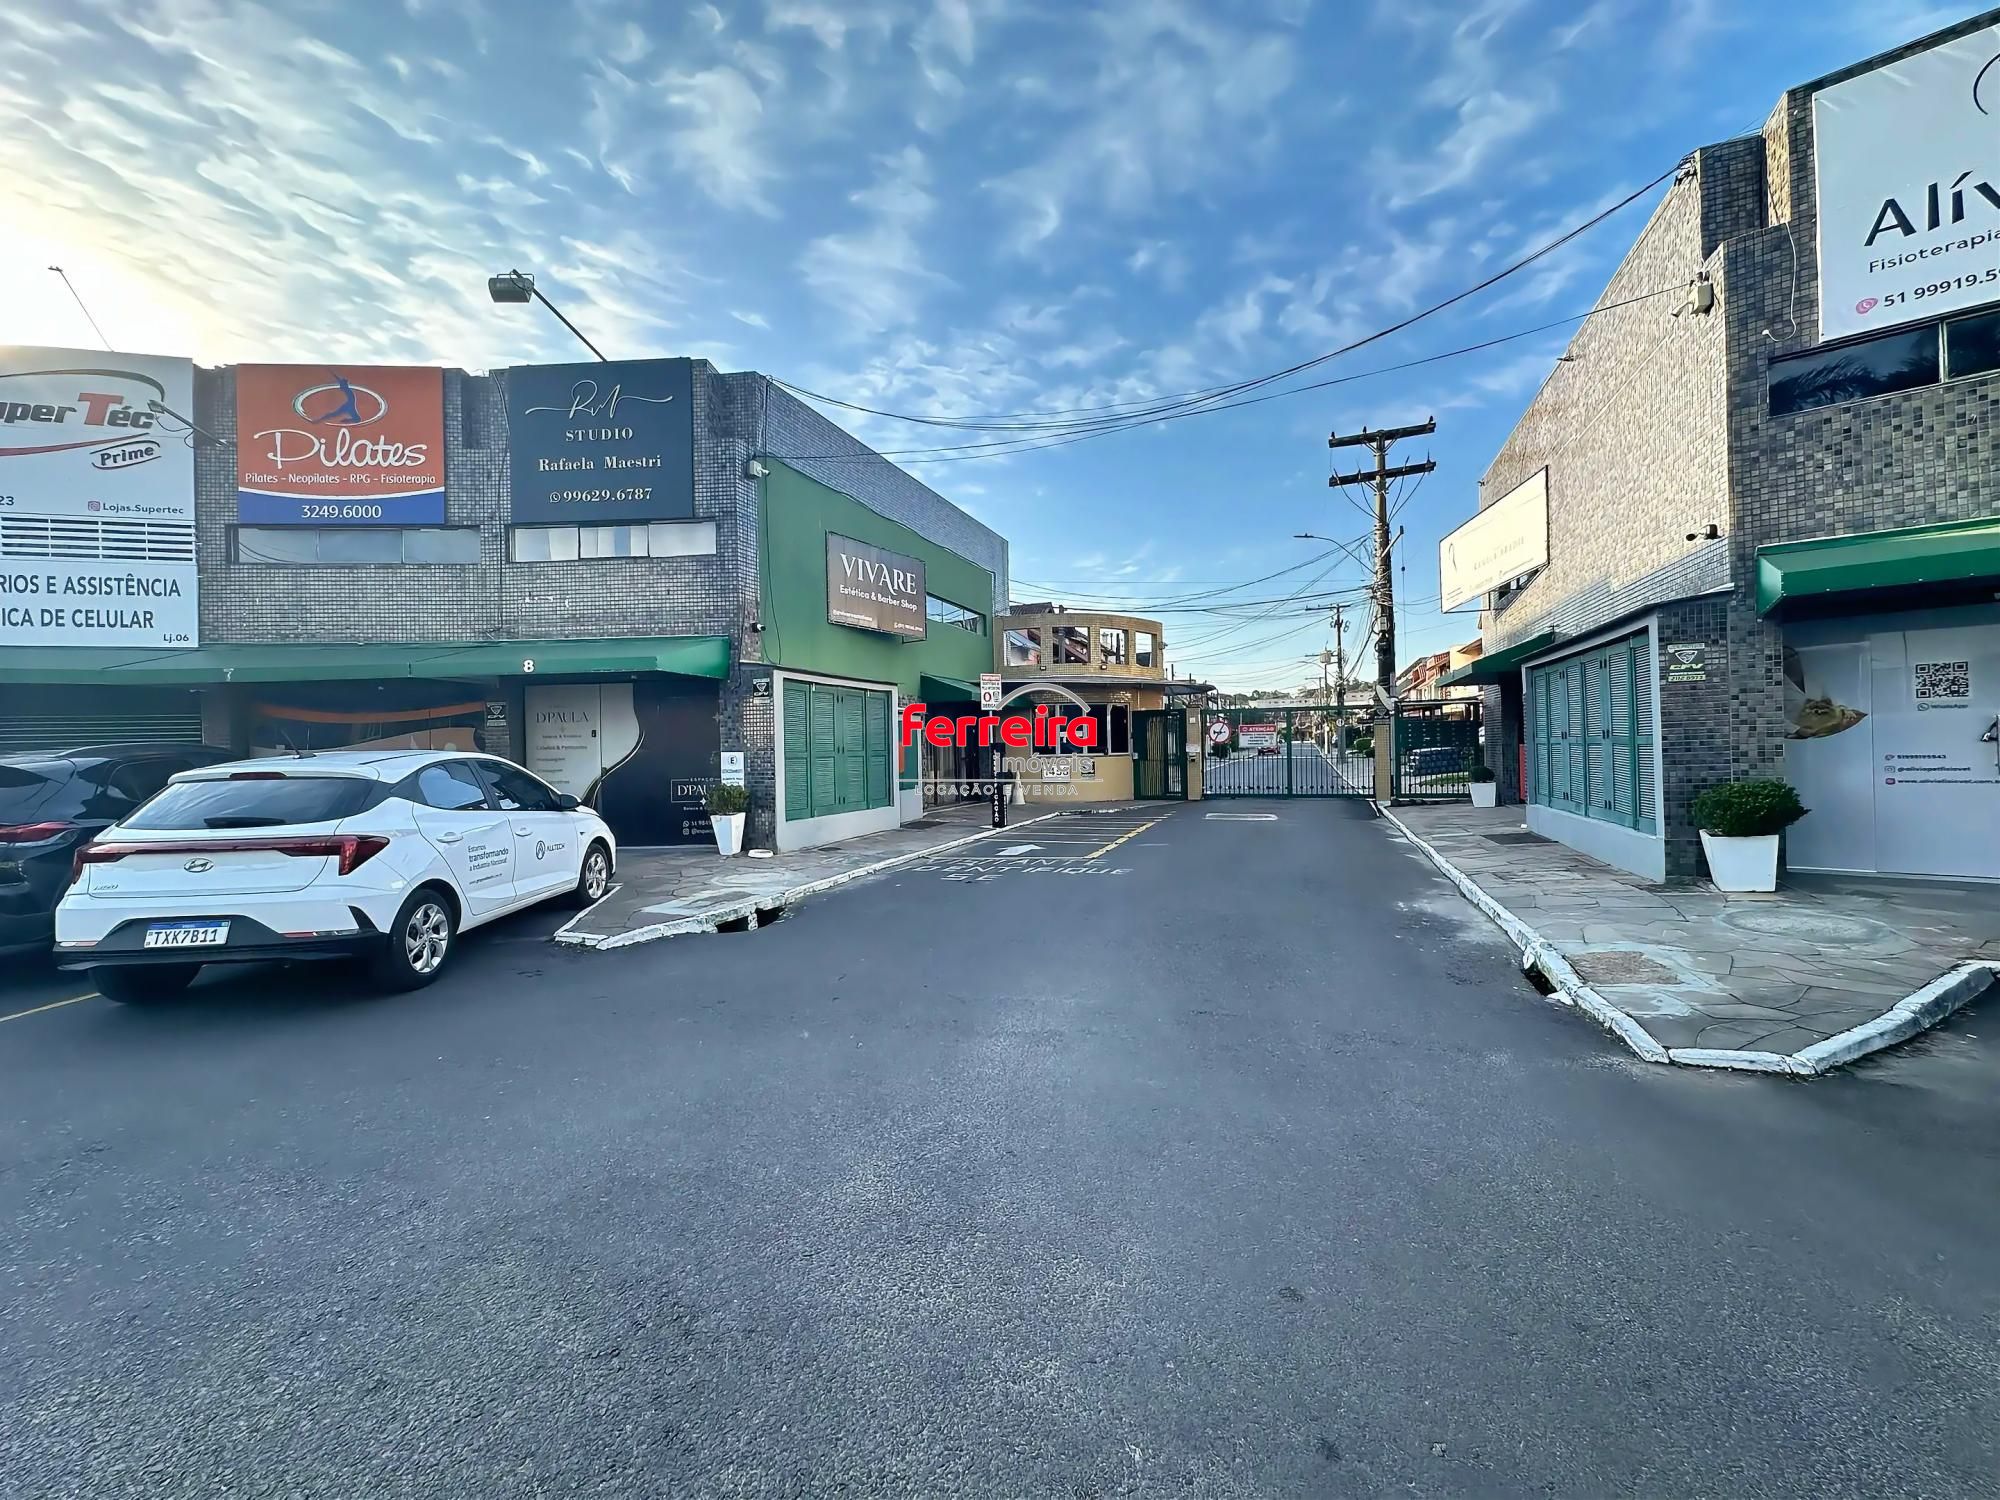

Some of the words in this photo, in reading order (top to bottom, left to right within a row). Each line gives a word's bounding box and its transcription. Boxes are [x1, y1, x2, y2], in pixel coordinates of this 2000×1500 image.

[1883, 291, 1905, 307] 51
[1913, 268, 2000, 300] 99919.5
[565, 427, 633, 441] STUDIO
[100, 445, 154, 467] Prime
[253, 428, 427, 469] Pilates
[538, 457, 594, 471] Rafaela
[604, 455, 661, 469] Maestri
[245, 473, 278, 483] Pilates
[288, 474, 340, 485] Neopilates
[350, 473, 370, 484] RPG
[381, 474, 436, 485] Fisioterapia
[563, 487, 652, 502] 99629.6787
[103, 502, 184, 515] Lojas.Supertec
[301, 505, 382, 518] 3249.6000
[840, 552, 917, 596] VIVARE
[46, 575, 57, 594] E
[63, 573, 181, 597] ASSISTÊNCIA
[840, 584, 870, 600] Estética
[870, 591, 877, 601] &
[878, 593, 900, 606] Barber
[900, 599, 917, 612] Shop
[2, 607, 34, 627] ICA
[41, 608, 65, 627] DE
[72, 608, 154, 629] CELULAR
[163, 633, 189, 643] Lj.06
[523, 660, 535, 672] 8
[223, 668, 235, 681] 7
[730, 757, 735, 765] E
[469, 848, 508, 862] transformando
[153, 929, 218, 945] TXK7B11
